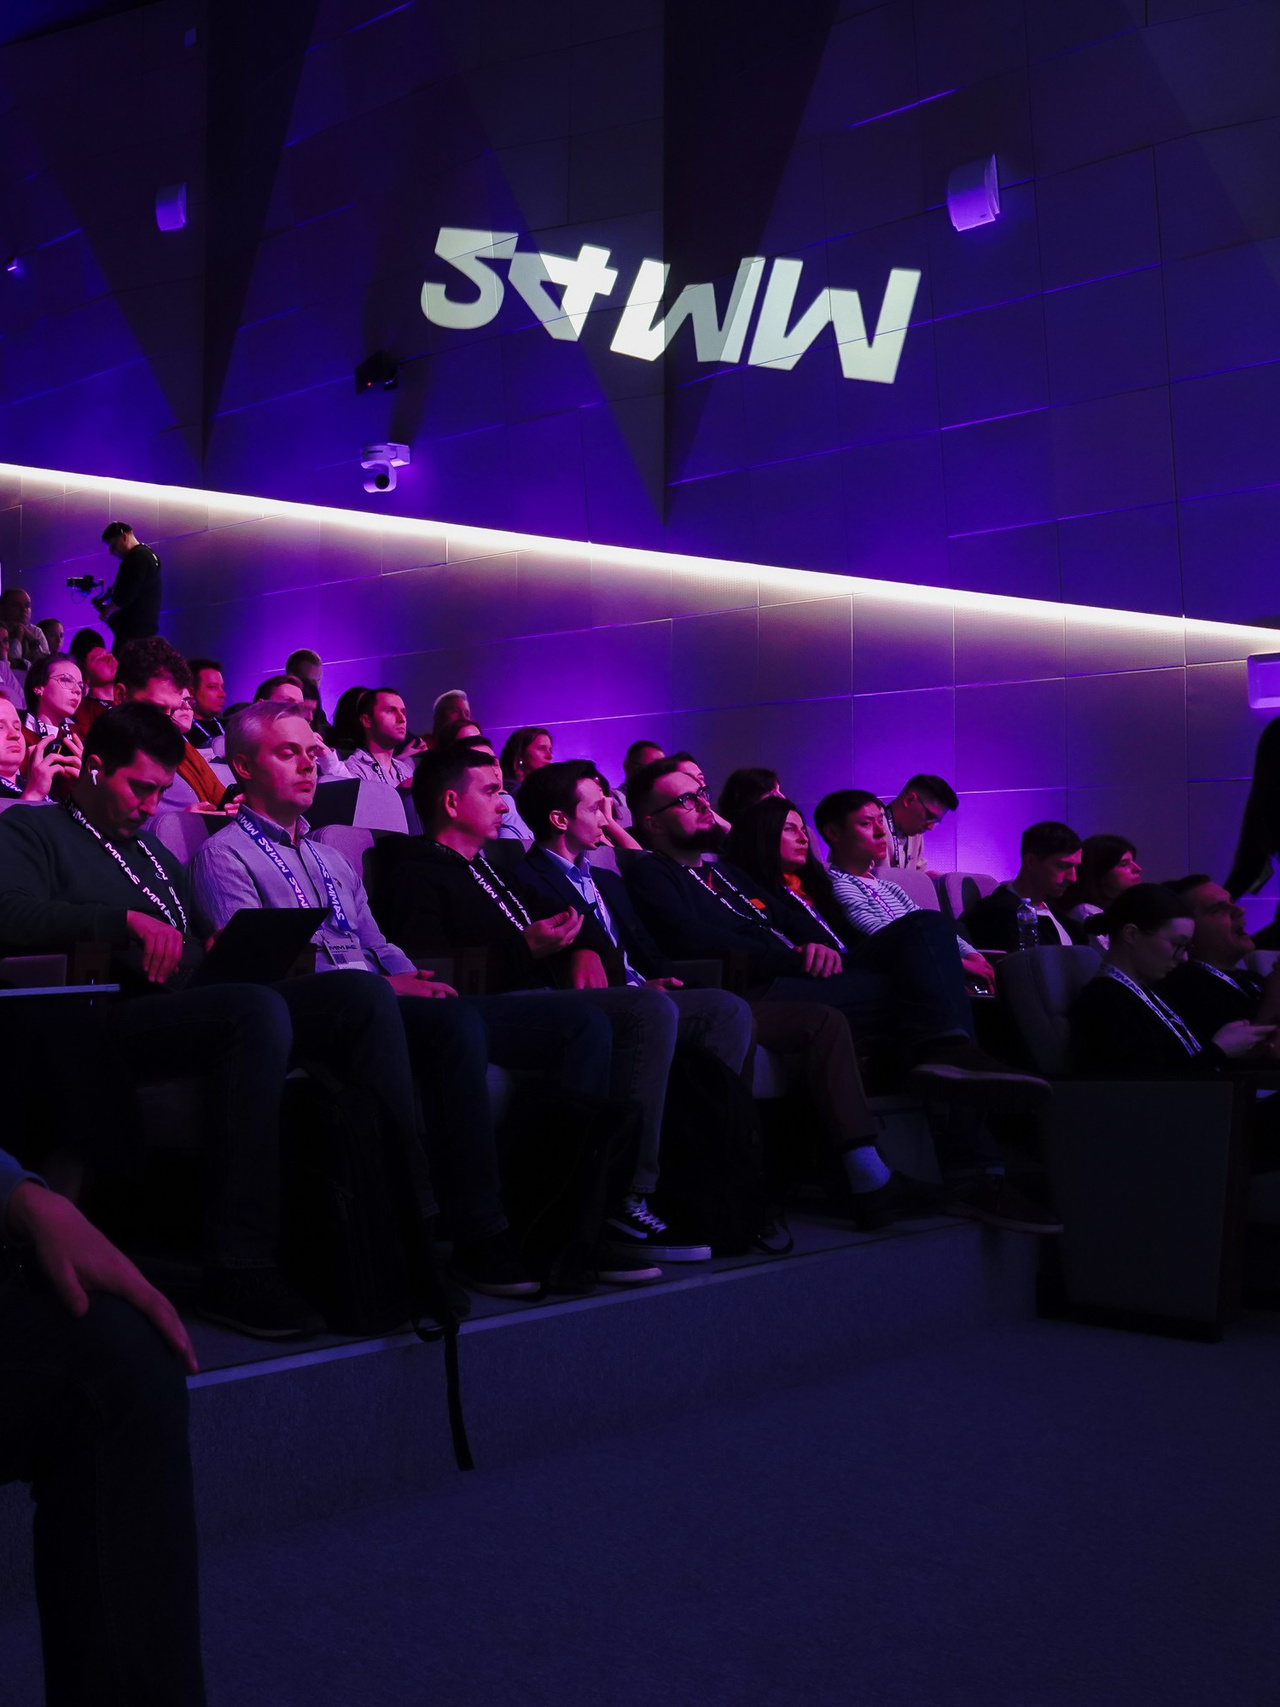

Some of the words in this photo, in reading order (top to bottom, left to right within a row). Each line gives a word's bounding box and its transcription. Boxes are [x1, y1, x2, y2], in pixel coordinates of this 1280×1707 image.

[104, 842, 141, 885] MMAS
[258, 836, 290, 874] MMAS
[326, 882, 346, 921] MMAS
